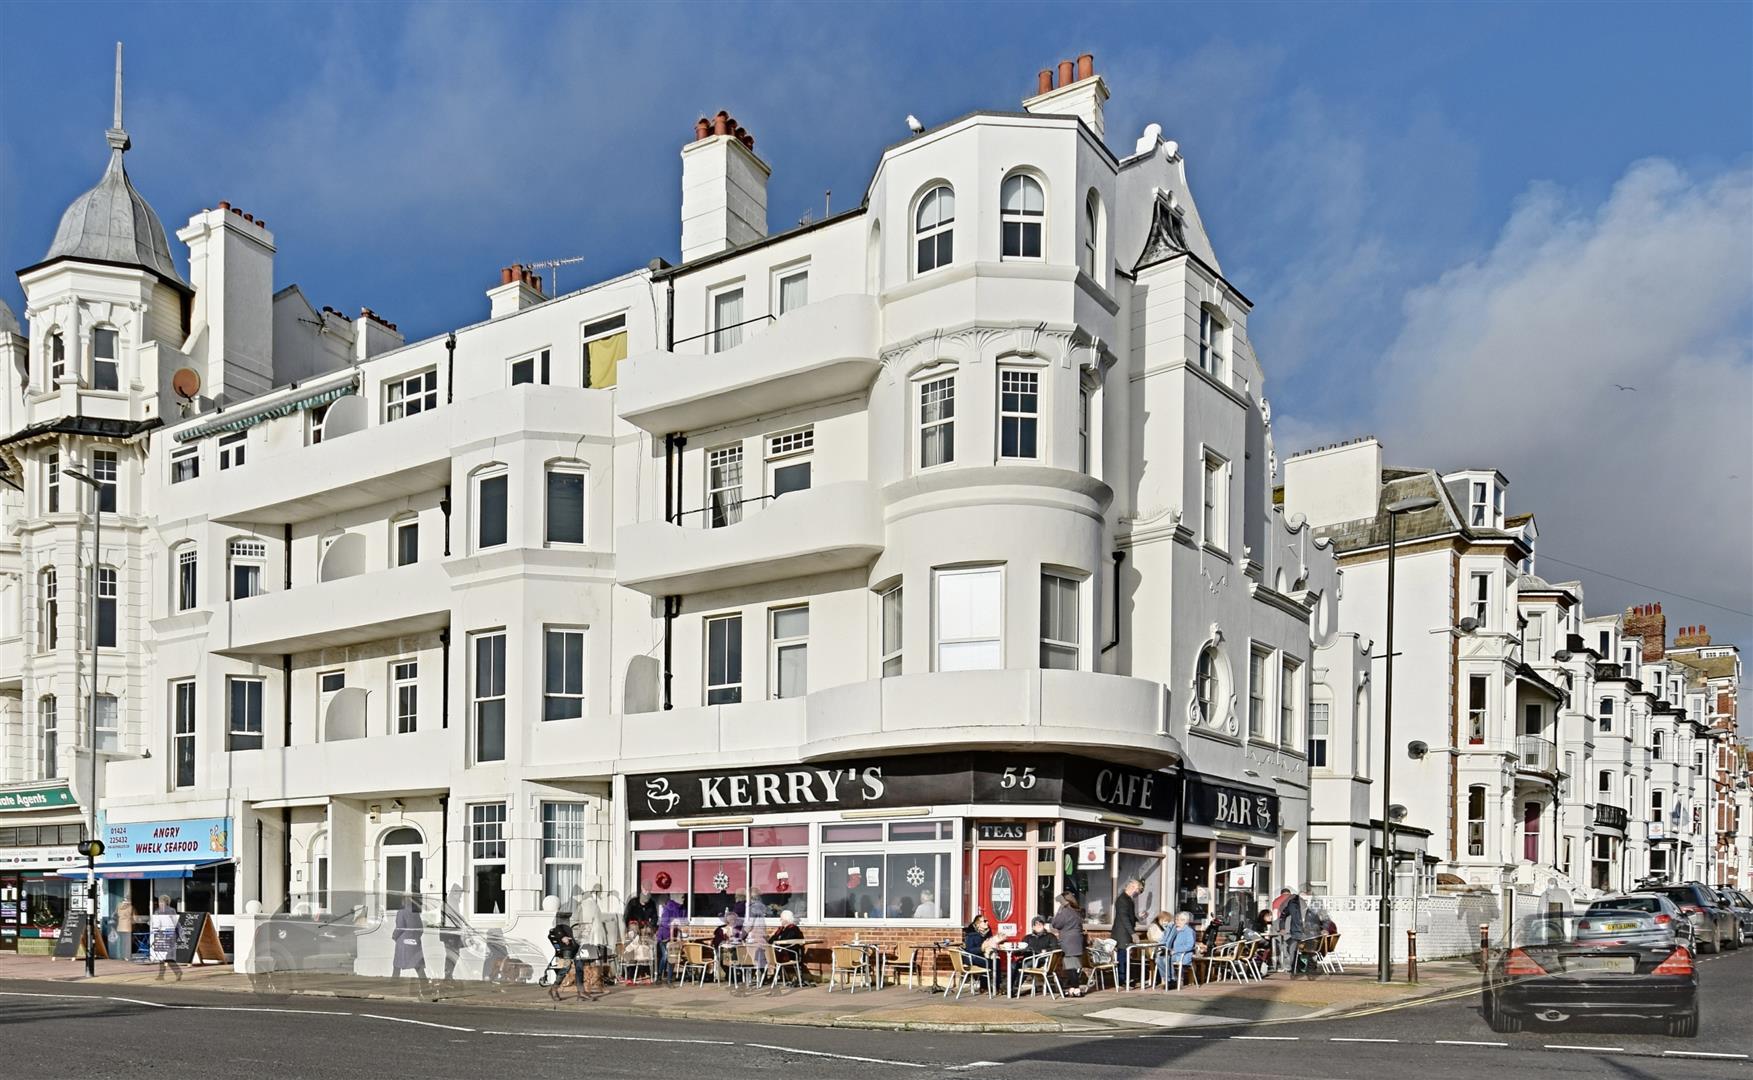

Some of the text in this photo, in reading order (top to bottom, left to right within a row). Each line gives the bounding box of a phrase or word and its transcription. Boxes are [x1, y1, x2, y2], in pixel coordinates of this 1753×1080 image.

[1000, 766, 1037, 790] 55
[699, 766, 885, 809] KERRY'S
[1095, 769, 1154, 810] CAFÉ
[16, 793, 47, 807] Agents
[1216, 792, 1252, 826] BAR
[110, 827, 127, 835] 01424
[153, 827, 180, 838] ANGRY
[981, 826, 1024, 838] TEAS
[109, 836, 128, 844] 225432
[135, 843, 162, 854] WHELK
[164, 840, 199, 853] SEAFOOD
